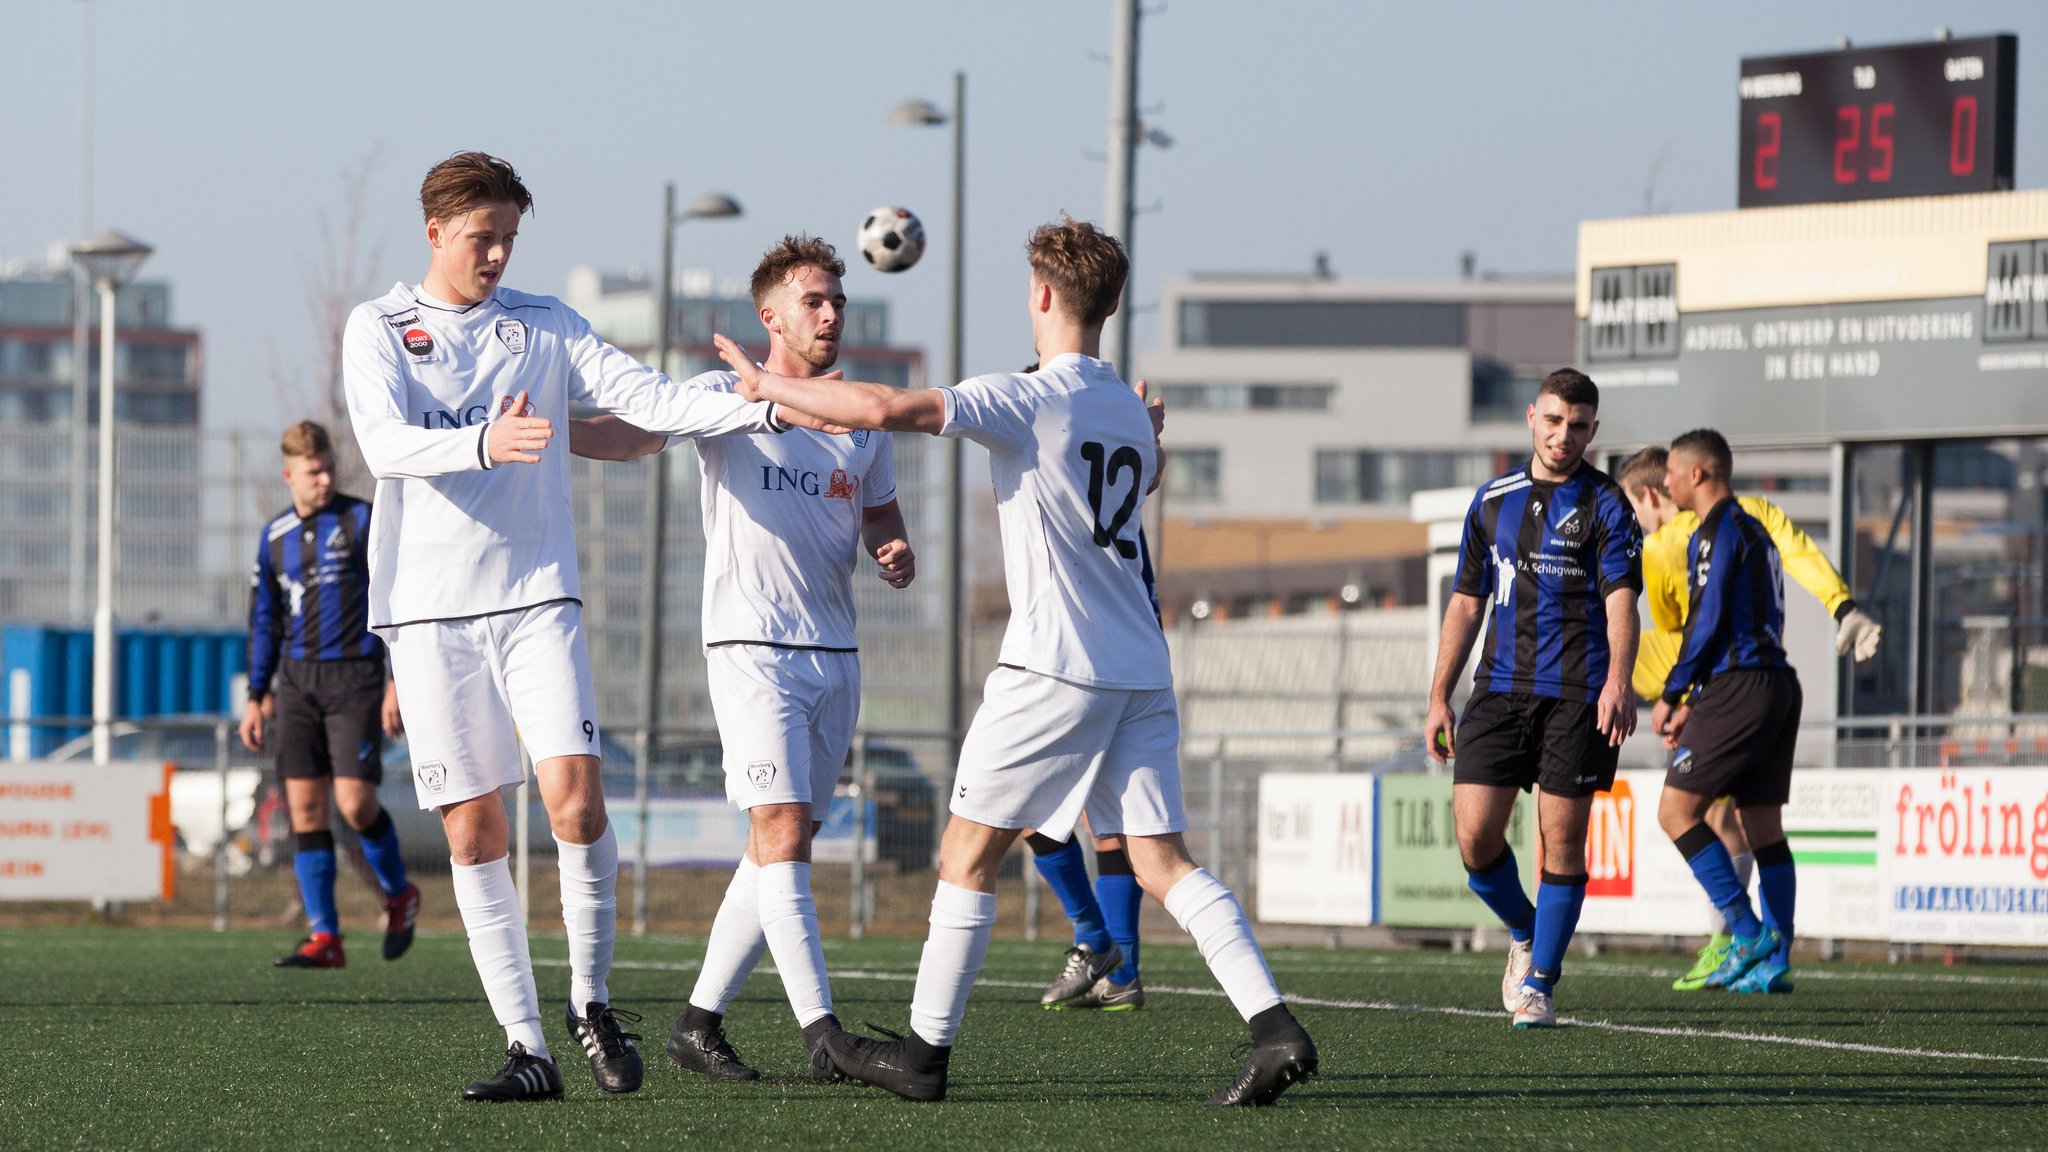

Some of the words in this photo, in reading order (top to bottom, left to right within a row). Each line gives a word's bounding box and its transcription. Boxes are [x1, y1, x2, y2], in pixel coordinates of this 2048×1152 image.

[1833, 102, 1895, 184] 25
[1949, 96, 1978, 176] 0
[1754, 112, 1781, 189] 2
[388, 315, 420, 329] hummel
[1838, 316, 1862, 344] EN
[407, 335, 428, 343] SPORT
[1828, 350, 1880, 378] HAND
[422, 405, 489, 430] ING
[761, 466, 819, 496] ING
[1081, 441, 1142, 560] 12
[1551, 538, 1565, 546] since
[1532, 562, 1587, 577] Schlagwein
[582, 719, 594, 742] 9
[1588, 797, 1632, 880] IN
